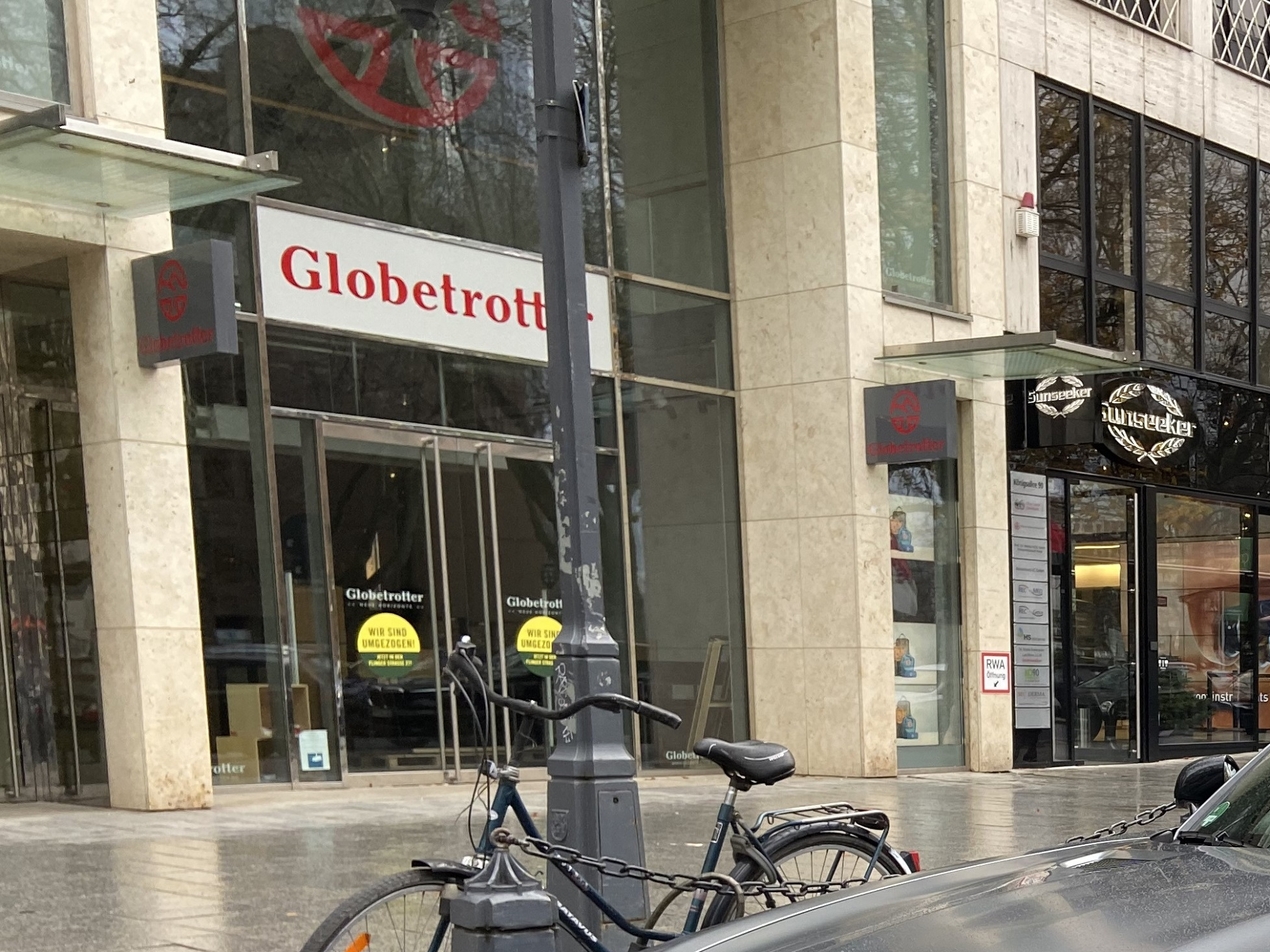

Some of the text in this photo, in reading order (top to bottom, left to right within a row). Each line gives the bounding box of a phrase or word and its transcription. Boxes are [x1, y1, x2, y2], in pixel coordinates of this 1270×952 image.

[1028, 387, 1093, 404] Sunseeker
[1101, 401, 1197, 438] Sunseeker
[346, 587, 424, 602] Globetrotter
[368, 627, 407, 637] WIR SIND
[527, 629, 542, 638] WIR
[362, 639, 415, 649] UMGEZOGEN!
[986, 658, 1006, 670] RWA
